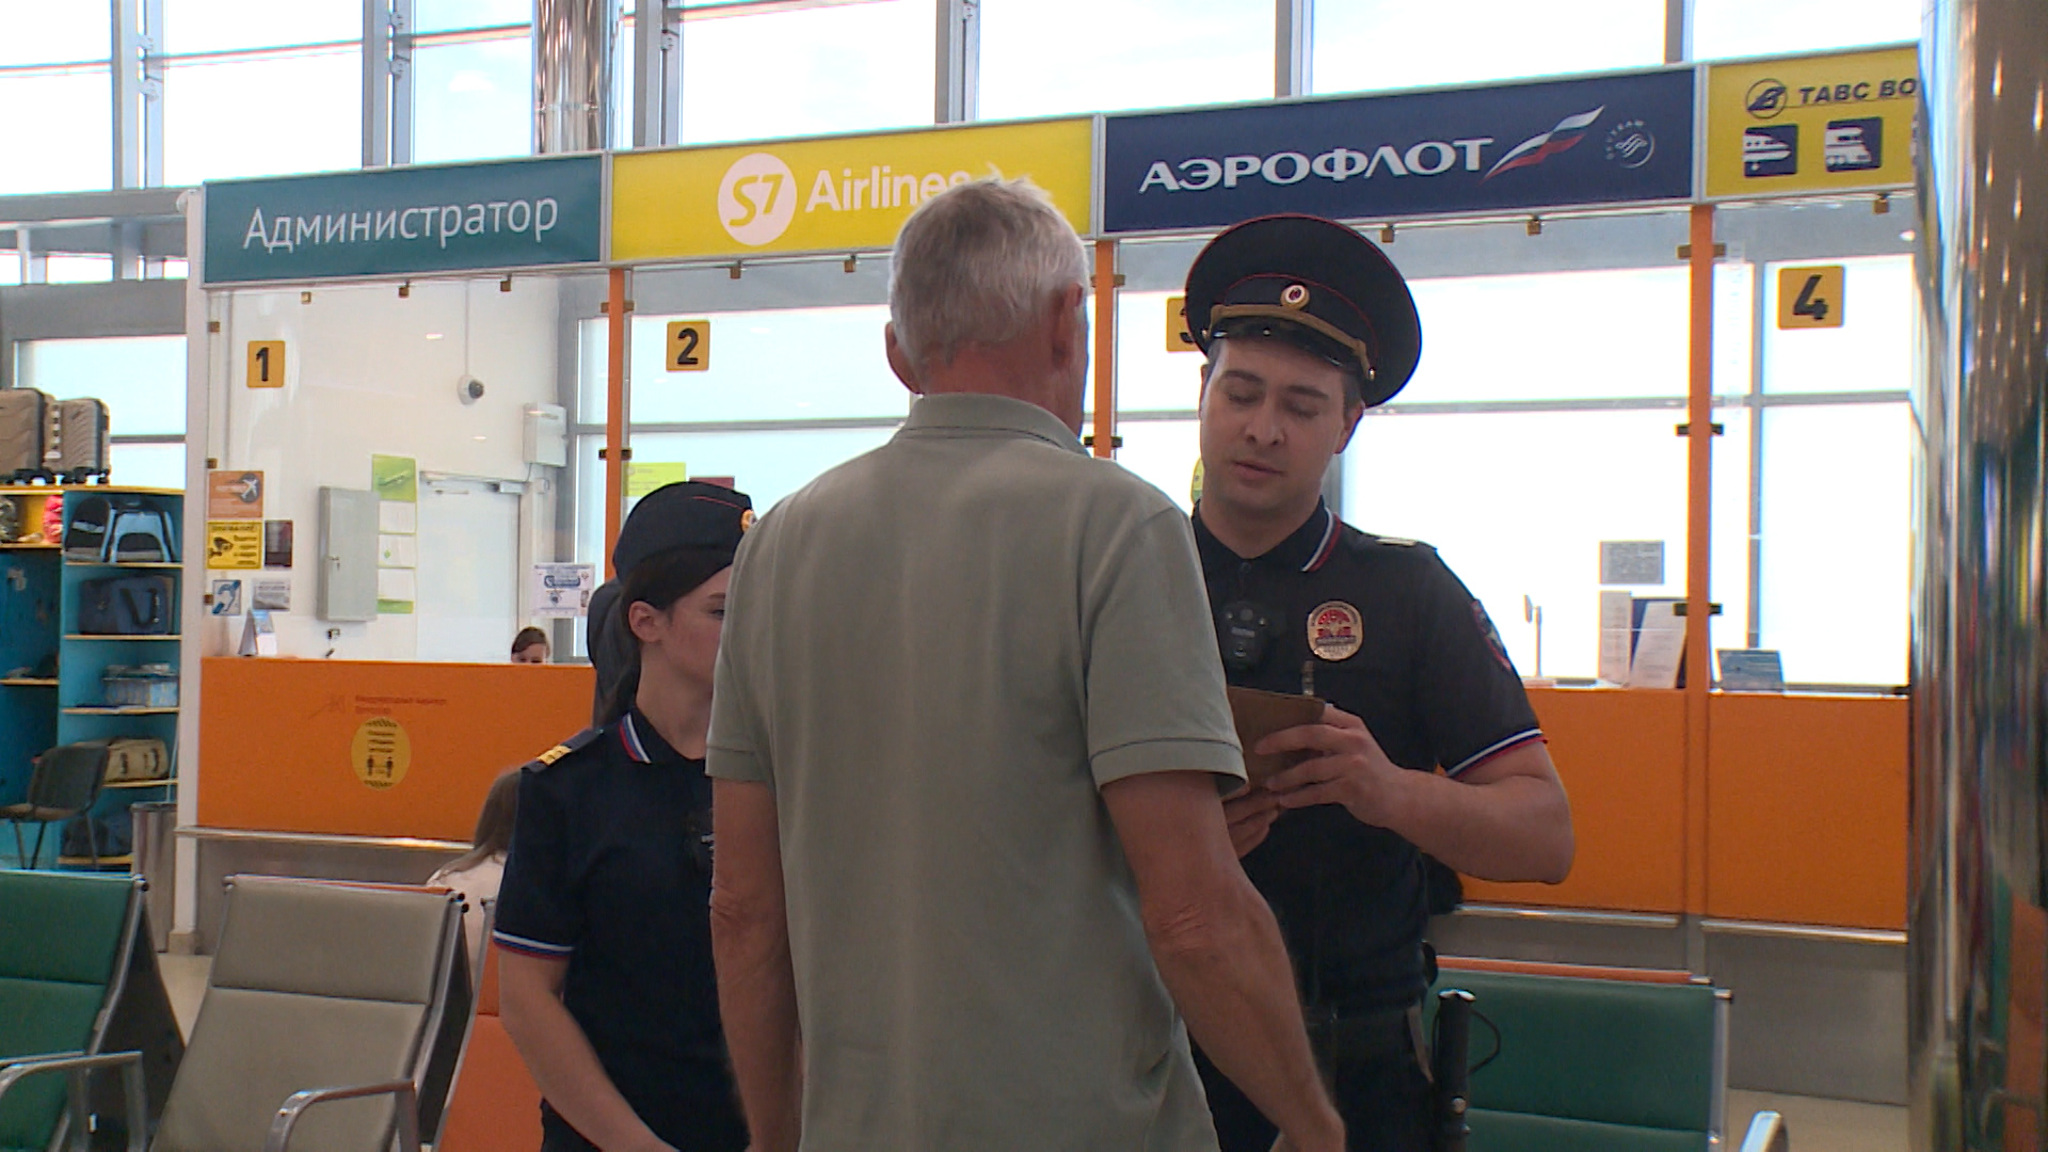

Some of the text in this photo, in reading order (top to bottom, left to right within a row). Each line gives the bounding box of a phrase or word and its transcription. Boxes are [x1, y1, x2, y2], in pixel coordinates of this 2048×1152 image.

[1798, 82, 1871, 105] ТАВС
[1138, 136, 1494, 193] АЭРОФЛОТ
[728, 174, 785, 226] S7
[243, 197, 558, 253] Администратор
[1793, 274, 1829, 320] 4
[255, 347, 270, 382] 1
[677, 328, 699, 365] 2
